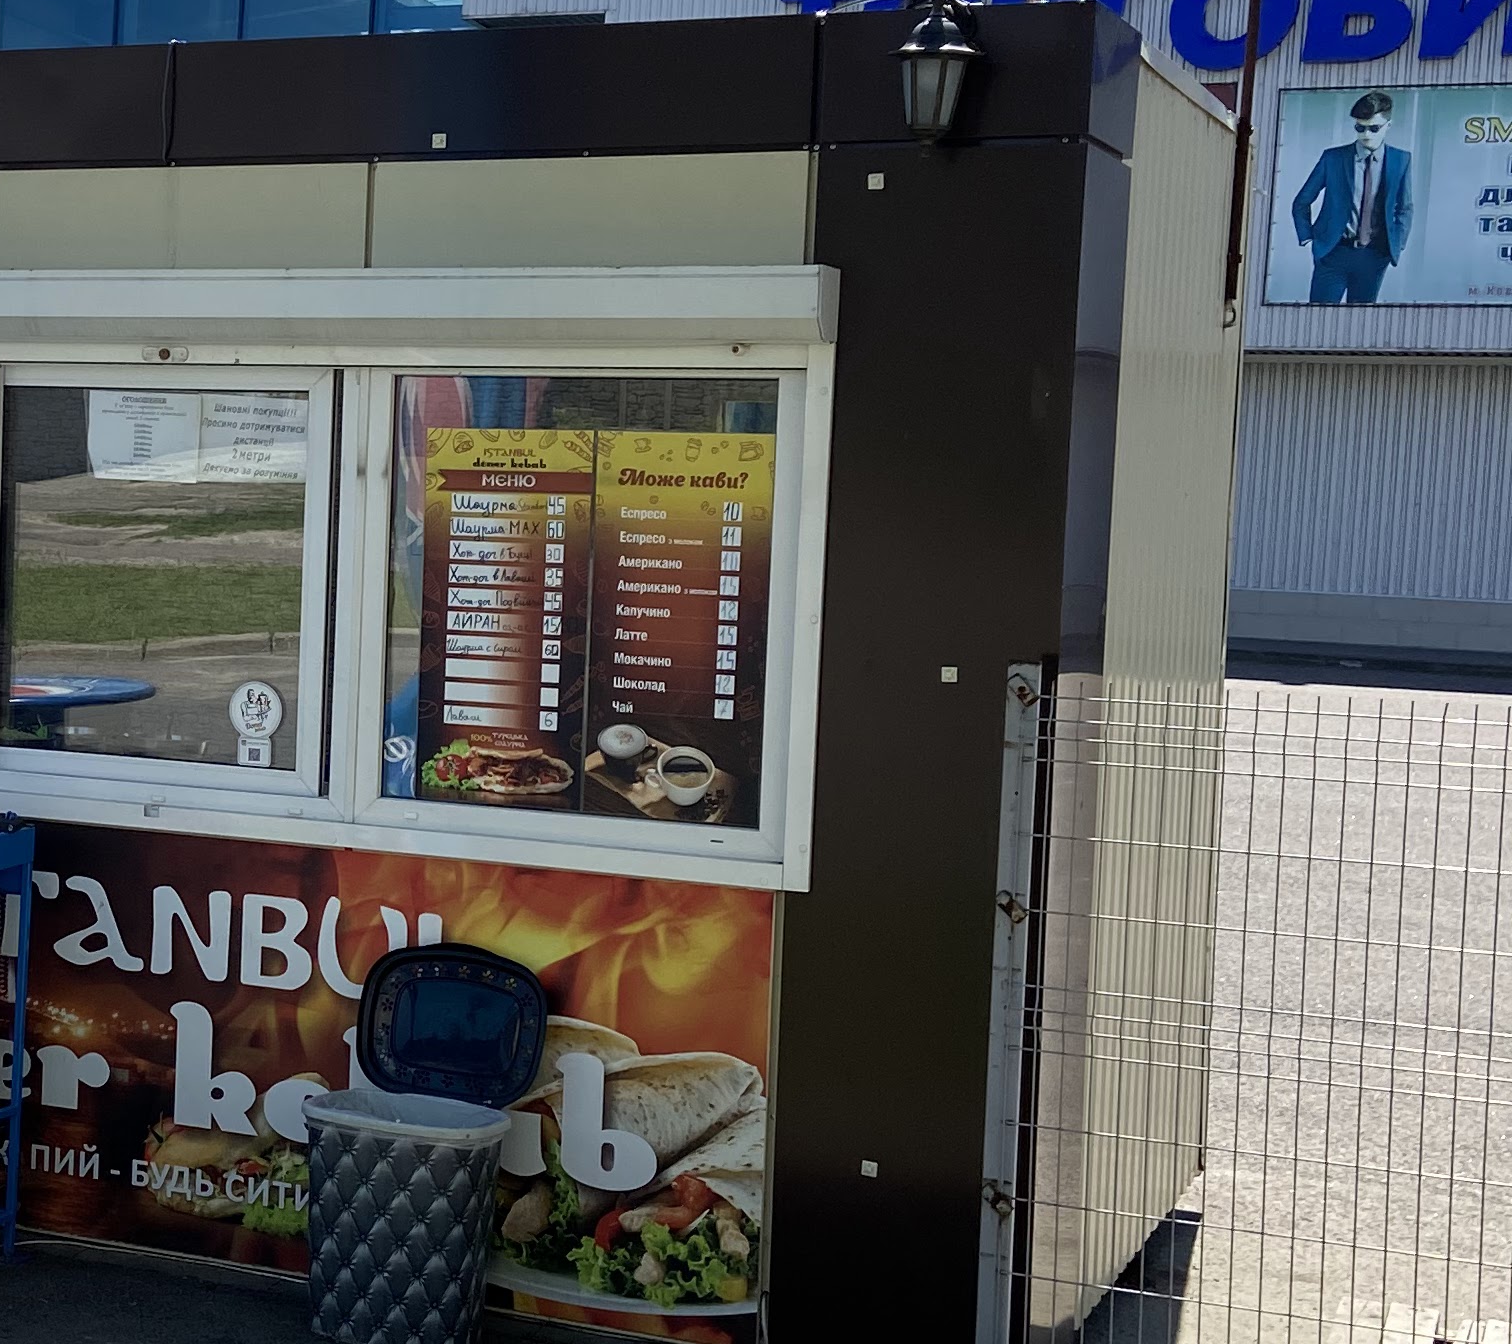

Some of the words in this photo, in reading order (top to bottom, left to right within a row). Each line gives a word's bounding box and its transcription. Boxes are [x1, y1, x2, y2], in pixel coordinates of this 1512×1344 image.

[214, 403, 251, 414] Шановні
[202, 417, 238, 429] Просимо
[239, 422, 305, 433] дотримуватися
[232, 448, 238, 459] 2
[239, 450, 271, 463] метри
[618, 468, 686, 487] Може
[689, 471, 749, 489] кави?
[548, 497, 565, 515] 45
[621, 507, 667, 520] Еспресо
[723, 502, 740, 521] 10
[547, 521, 564, 538] 60
[723, 527, 736, 545] 11
[619, 531, 666, 545] Еспресо
[547, 548, 561, 561] 30
[618, 555, 683, 570] Американо
[545, 569, 563, 587] 35
[617, 580, 682, 595] Американо
[544, 593, 562, 611] 45
[616, 604, 671, 618] Капучино
[452, 612, 500, 630] АЙРАН
[614, 628, 648, 641] Латте
[545, 644, 559, 656] 60
[613, 652, 671, 667] Мокачино
[613, 677, 666, 693] Шоколад
[612, 701, 633, 714] Чай
[544, 713, 553, 727] 6
[30, 1143, 100, 1179] ПИЙ
[131, 1160, 214, 1200] БУДЬ
